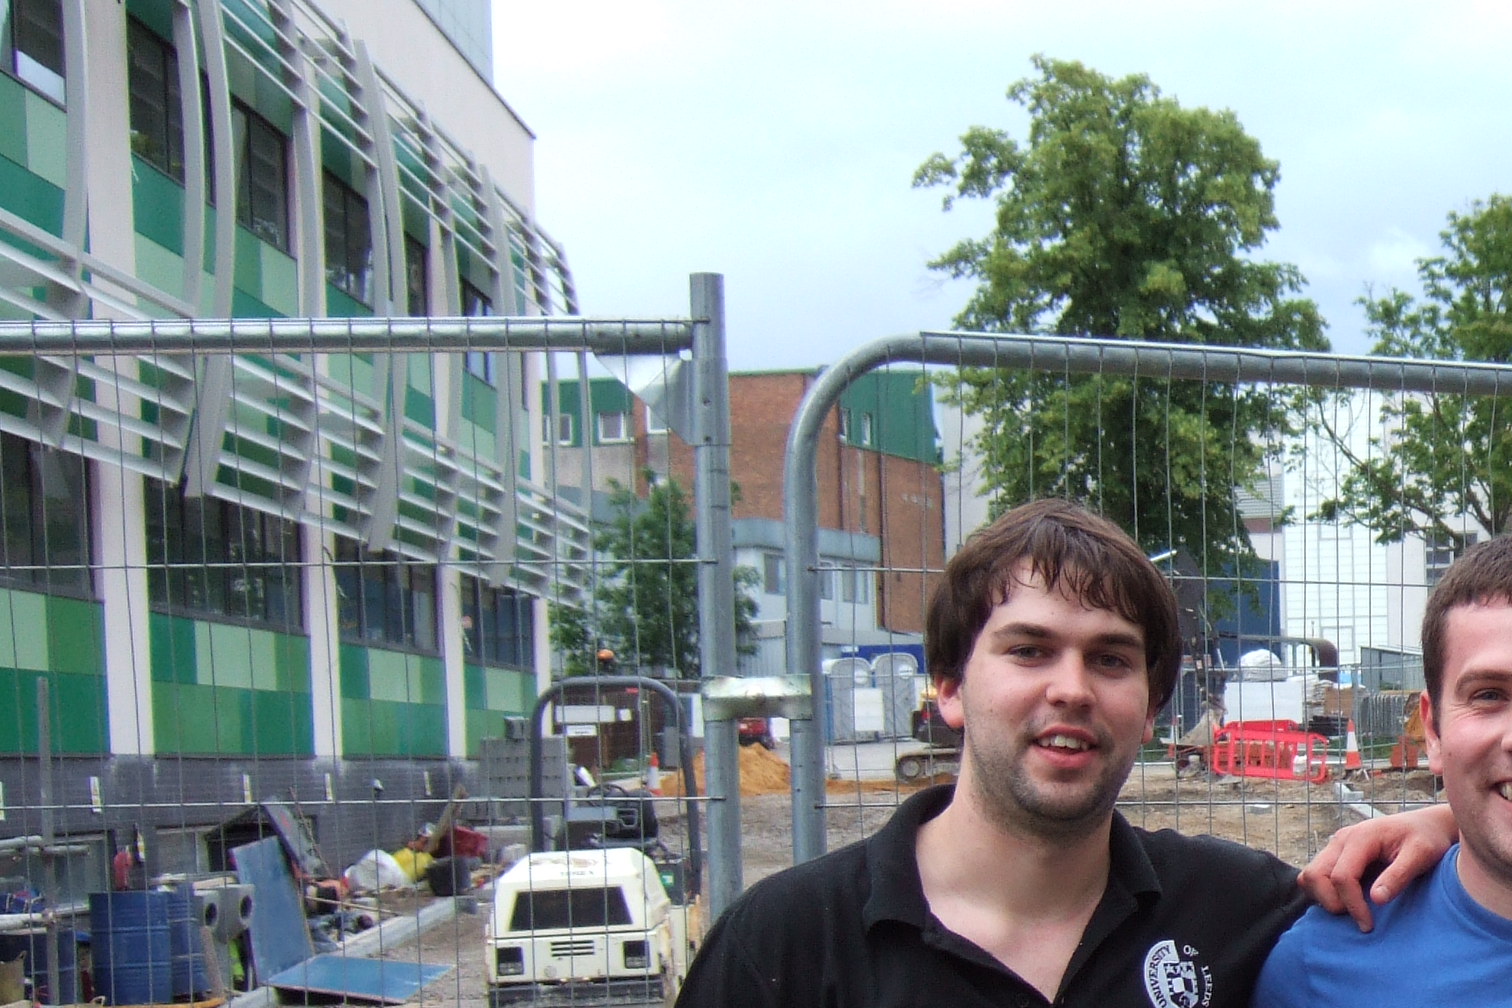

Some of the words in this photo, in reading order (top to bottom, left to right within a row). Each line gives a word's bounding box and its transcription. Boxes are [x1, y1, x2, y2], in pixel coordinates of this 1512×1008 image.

[1148, 944, 1171, 1008] UNIVERSITY
[1183, 944, 1199, 957] OF
[1200, 965, 1213, 1008] LEEDS
